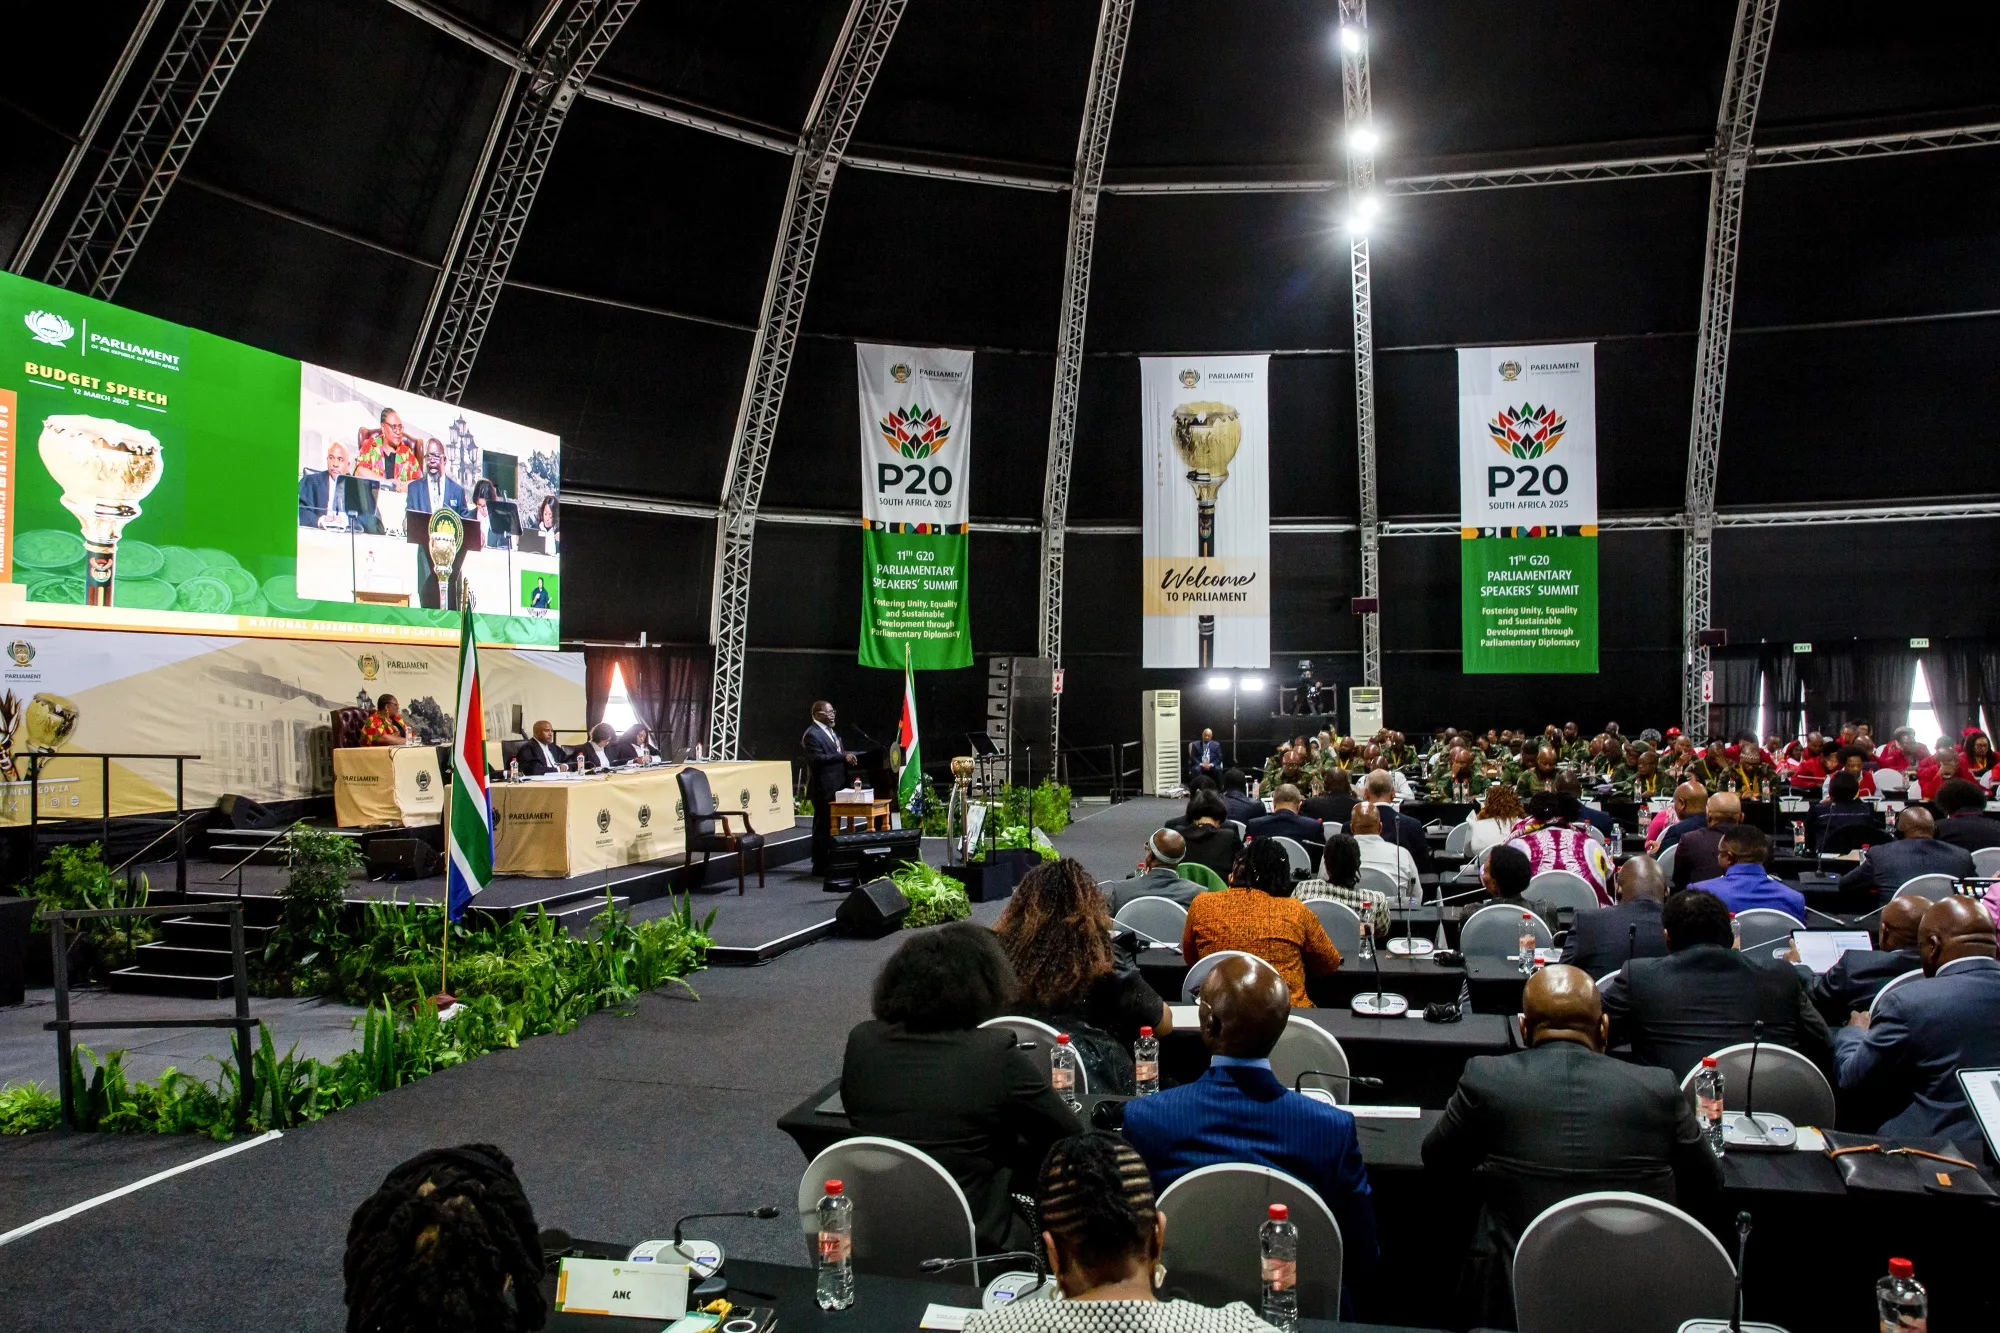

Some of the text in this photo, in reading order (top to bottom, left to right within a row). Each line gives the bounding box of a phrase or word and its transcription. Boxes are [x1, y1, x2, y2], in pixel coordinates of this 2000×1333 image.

[91, 333, 180, 364] PARLIAMENT
[1530, 362, 1579, 371] PARLIAMENT
[919, 368, 963, 378] PARLIAMENT
[25, 361, 168, 406] BUDGET SPEECH
[83, 390, 110, 401] MARCH
[113, 397, 130, 406] 2025
[878, 463, 952, 495] P20
[1488, 464, 1568, 497] P20
[879, 497, 952, 508] SOUTH AFRICA 2025
[1488, 500, 1569, 510] SOUTH AFRICA 2025
[916, 551, 935, 561] G20
[1529, 555, 1550, 566] G20
[876, 564, 955, 576] PARLIAMENTARY
[1487, 570, 1572, 581] PARLIAMENTARY
[1161, 565, 1256, 589] Welcome
[923, 580, 959, 590] SUMMIT
[1538, 584, 1579, 596] SUMMIT
[1167, 592, 1247, 601] TO PARLIAMENT
[873, 598, 958, 609] Fostering Unity, Equality
[885, 609, 945, 618] and Sustainable
[1482, 606, 1578, 616] Fostering Unity, Equality
[249, 618, 308, 630] NATIONAL
[312, 622, 365, 634] ASSEMBLY
[876, 619, 955, 630] Development through
[1498, 616, 1561, 625] and Sustainable
[871, 628, 961, 640] Parliamentary Diplomacy
[1486, 627, 1574, 637] Development through
[1480, 637, 1580, 648] Parliamentary Diplomacy
[387, 661, 429, 669] PARLIAMENT
[508, 812, 553, 820] PARLIAMENT
[612, 1290, 631, 1300] ANC
